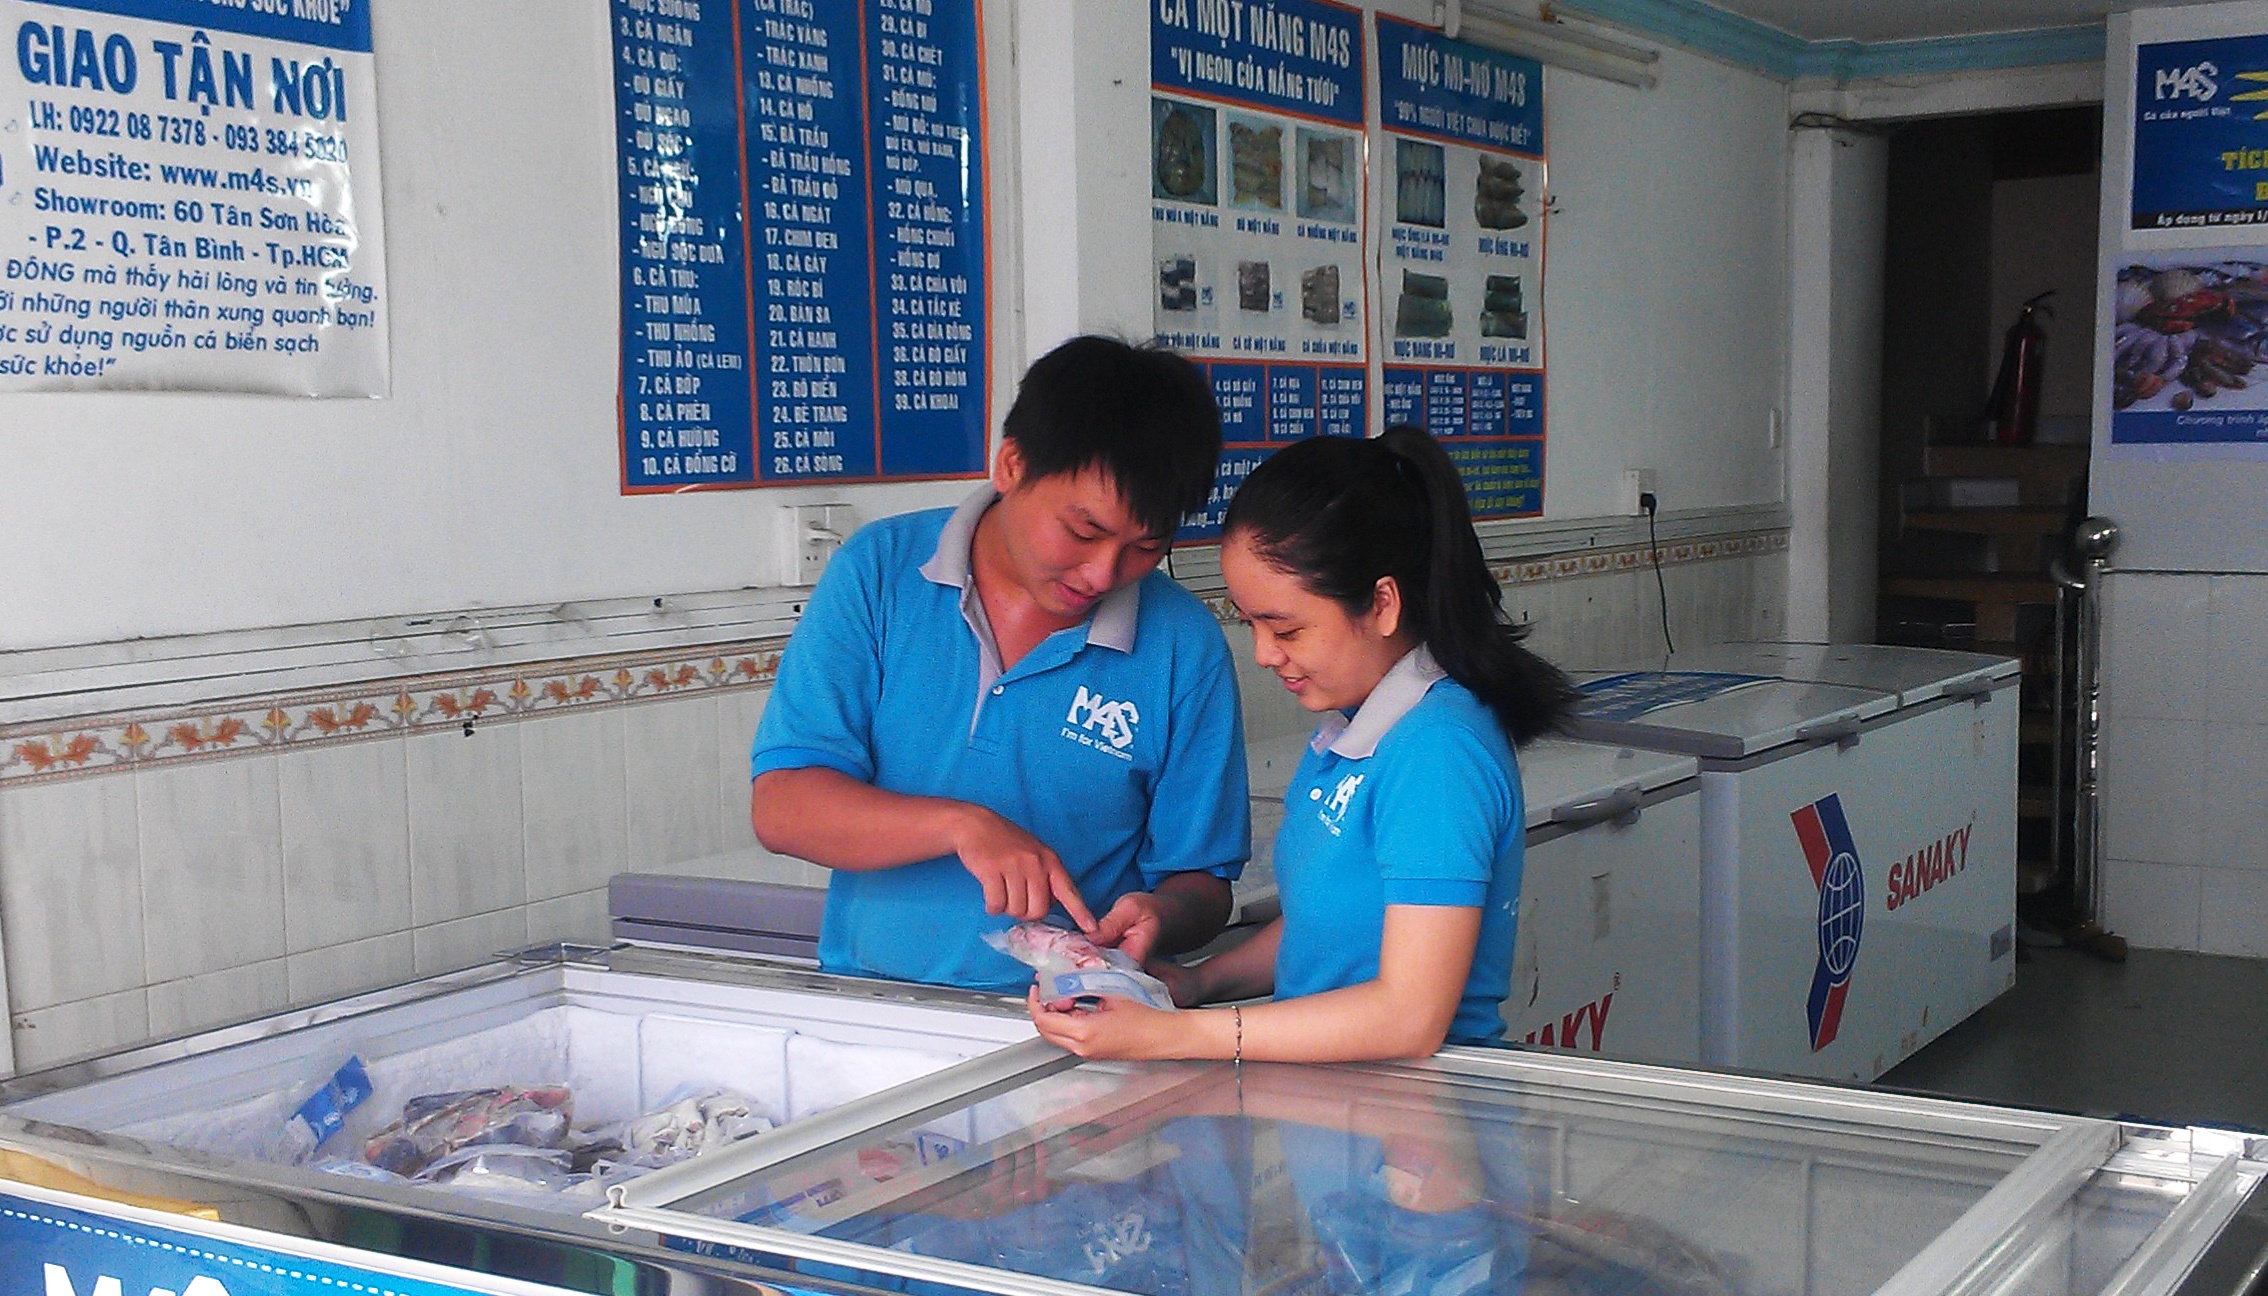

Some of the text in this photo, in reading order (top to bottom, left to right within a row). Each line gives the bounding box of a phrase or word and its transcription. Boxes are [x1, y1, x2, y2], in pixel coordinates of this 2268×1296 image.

[1309, 20, 1350, 69] M4S
[17, 21, 347, 122] GIAO TẬN NƠI
[1195, 51, 1233, 86] NGON
[1236, 53, 1265, 93] CỦA
[1494, 66, 1527, 108] M4S
[2155, 61, 2218, 101] M4S
[30, 100, 63, 131] LH:
[70, 105, 121, 137] 0922
[127, 111, 152, 140] 08
[157, 115, 207, 147] 7378
[225, 123, 260, 153] 093
[265, 128, 300, 158] 384
[34, 144, 152, 182] Website:
[34, 186, 166, 221] Showroom:
[173, 200, 204, 224] 60
[211, 202, 253, 227] Tân
[259, 206, 300, 232] Sơn
[46, 226, 87, 251] P.2
[112, 230, 136, 258] Q.
[143, 232, 188, 258] Tân
[195, 236, 246, 262] Bình
[83, 263, 118, 285] mà
[126, 262, 171, 292] thấy
[217, 271, 258, 298] lòng
[265, 275, 288, 295] và
[295, 278, 318, 296] tin
[21, 292, 375, 331] những người thân xung quanh bạn!
[25, 320, 320, 357] sử dụng nguồn cá biển sạch
[1066, 685, 1140, 750] M4S
[1886, 823, 1973, 912] SANAKY
